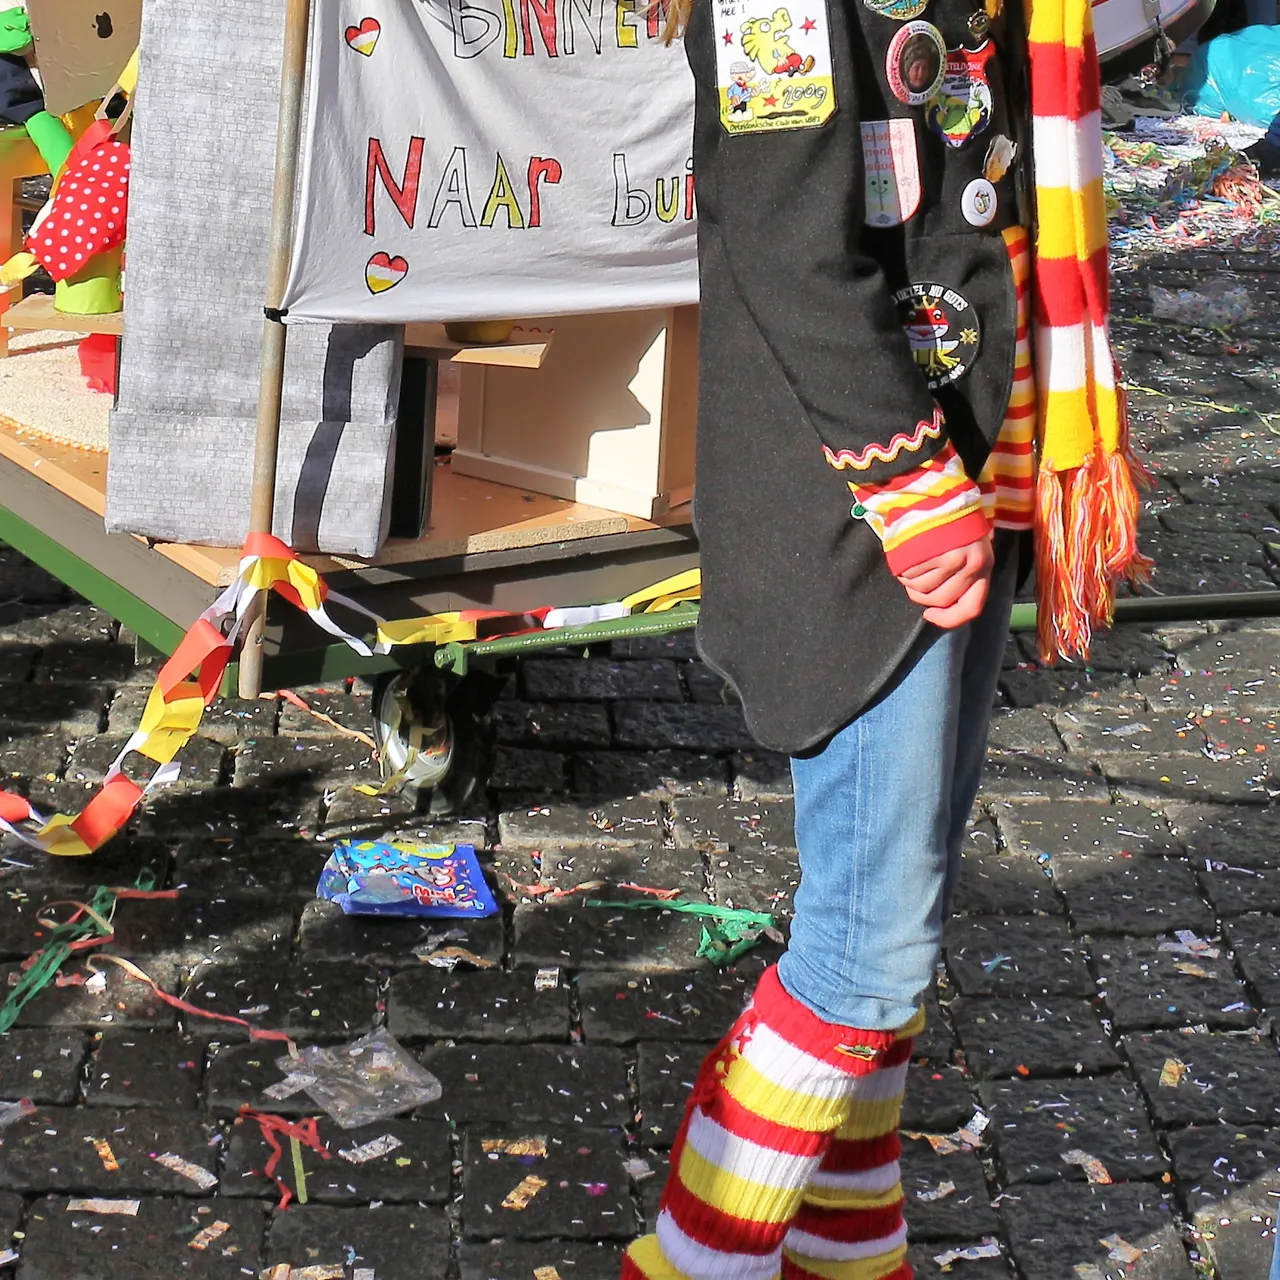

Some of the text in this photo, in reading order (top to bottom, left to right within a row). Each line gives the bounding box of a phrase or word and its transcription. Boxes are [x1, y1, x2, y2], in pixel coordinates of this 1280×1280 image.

[944, 61, 983, 72] ETELDONK
[782, 83, 827, 110] 2009
[928, 284, 944, 298] NO
[943, 289, 969, 312] GUTS
